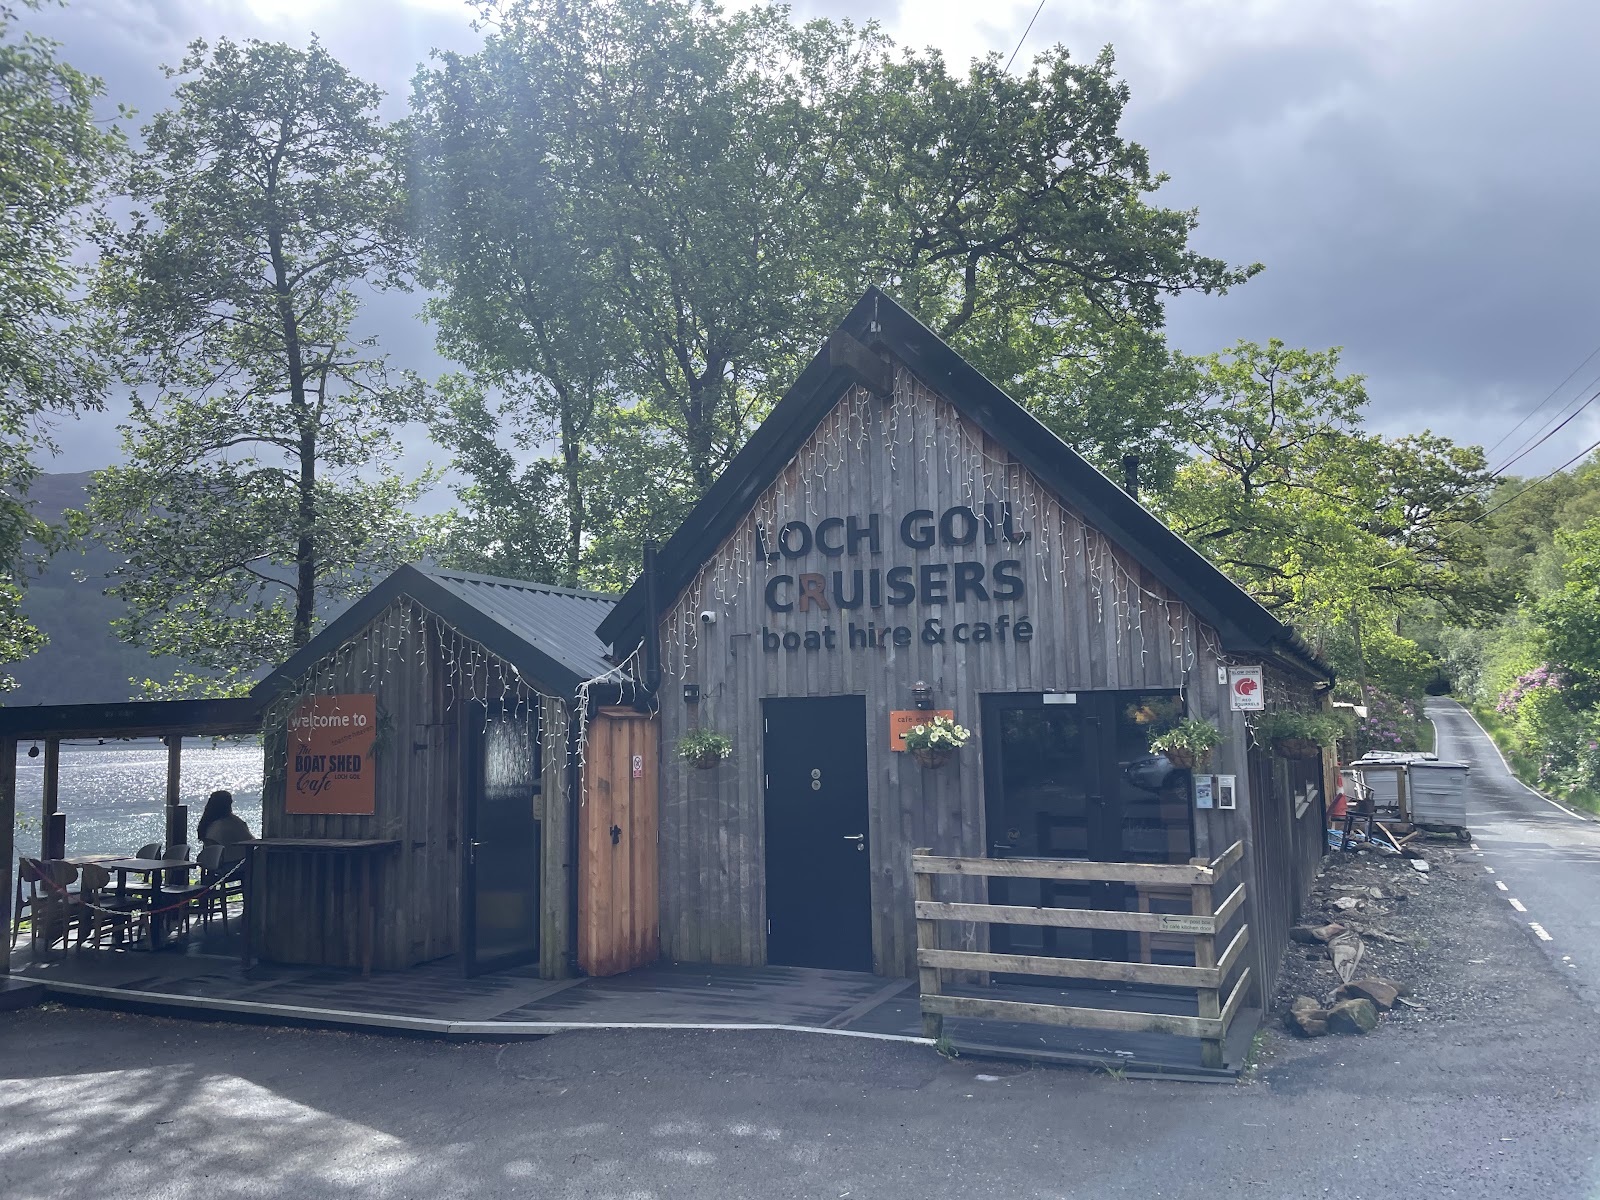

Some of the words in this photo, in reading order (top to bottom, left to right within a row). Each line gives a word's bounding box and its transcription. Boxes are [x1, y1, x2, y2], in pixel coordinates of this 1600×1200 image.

[756, 514, 882, 562] LOCH
[900, 501, 1032, 550] GOIL
[764, 560, 1026, 613] CRUISERS
[762, 625, 836, 652] boat
[849, 621, 912, 650] hire
[921, 618, 947, 645] &
[953, 614, 1034, 644] café
[291, 711, 350, 728] welcome
[353, 712, 367, 727] to
[298, 744, 312, 754] The
[295, 755, 327, 773] BOAT
[328, 755, 362, 772] SHED
